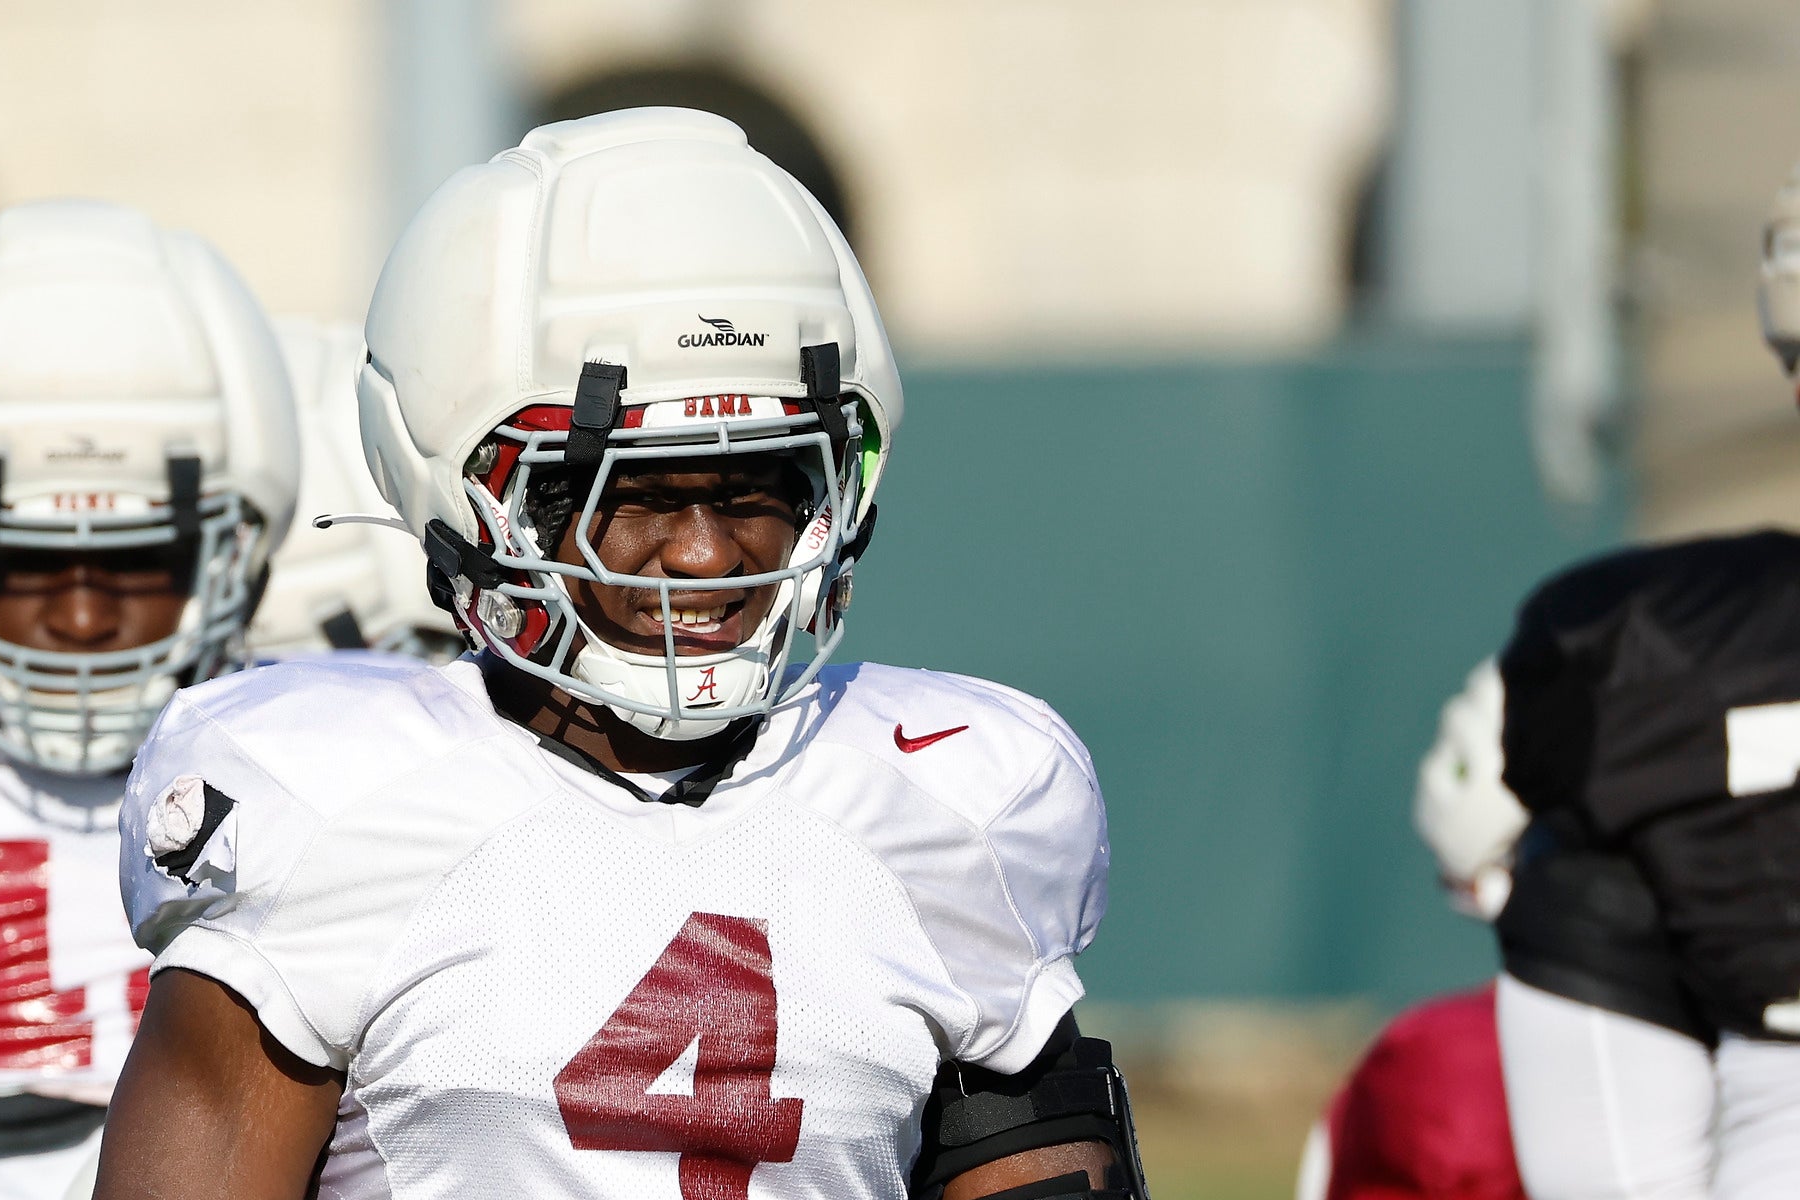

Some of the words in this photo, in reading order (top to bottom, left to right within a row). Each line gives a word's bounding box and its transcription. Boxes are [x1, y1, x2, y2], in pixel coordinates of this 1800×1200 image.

[677, 332, 766, 349] GUARDIAN
[684, 393, 753, 418] BAMA
[686, 666, 718, 701] A
